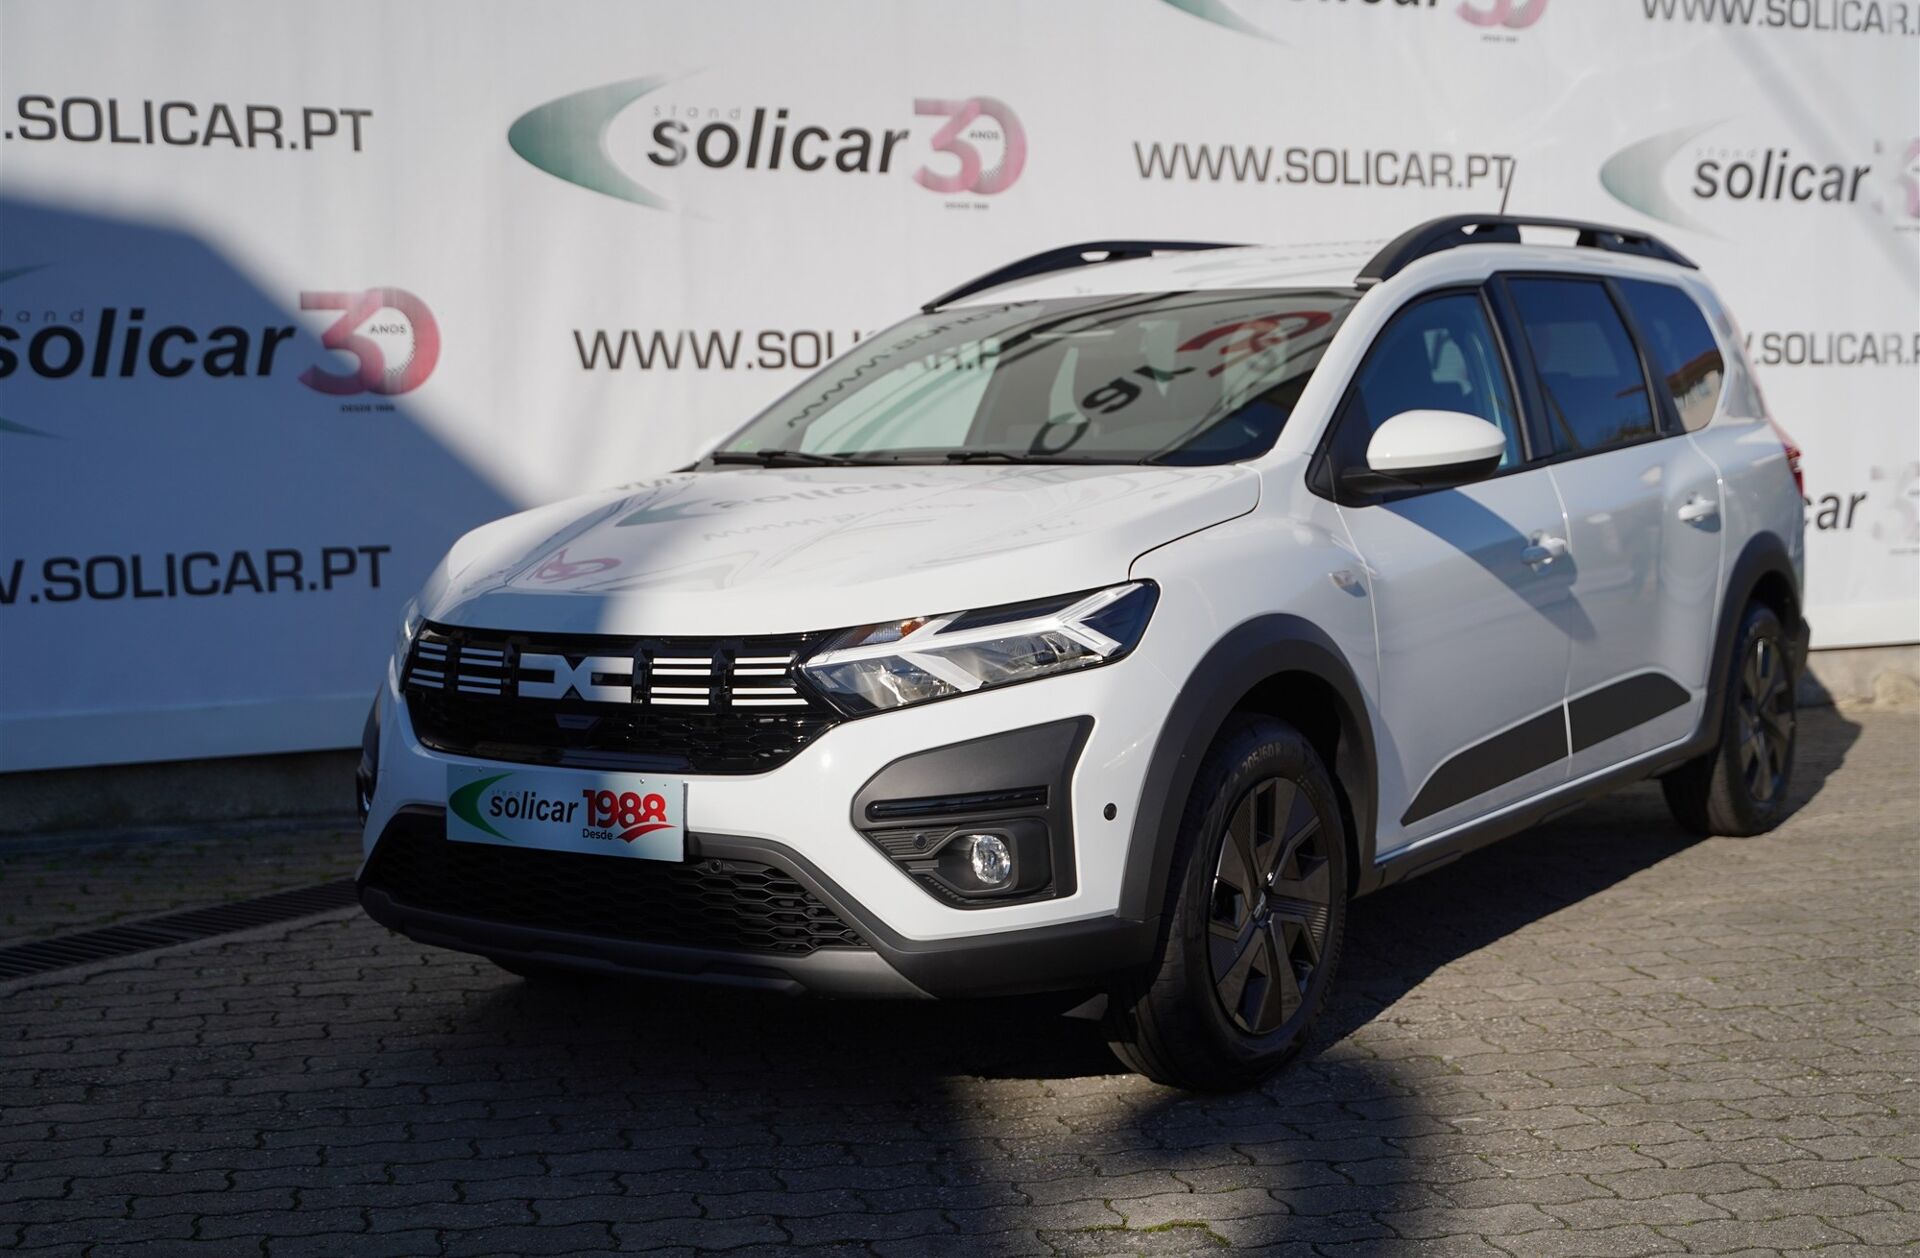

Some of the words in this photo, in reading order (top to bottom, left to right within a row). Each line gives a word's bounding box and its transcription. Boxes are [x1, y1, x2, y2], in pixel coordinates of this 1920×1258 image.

[1643, 0, 1920, 36] WWW.SOLICAR.
[647, 107, 909, 173] solicar
[911, 96, 1027, 195] 30
[1133, 140, 1512, 191] WWW.SOLICAR.PT
[1692, 148, 1872, 203] solicar
[299, 287, 441, 396] 30
[369, 323, 407, 335] ANOS
[1745, 331, 1920, 367] .SOLICAR.
[489, 791, 579, 824] solicar
[582, 789, 667, 829] 1988
[582, 828, 614, 841] Desde
